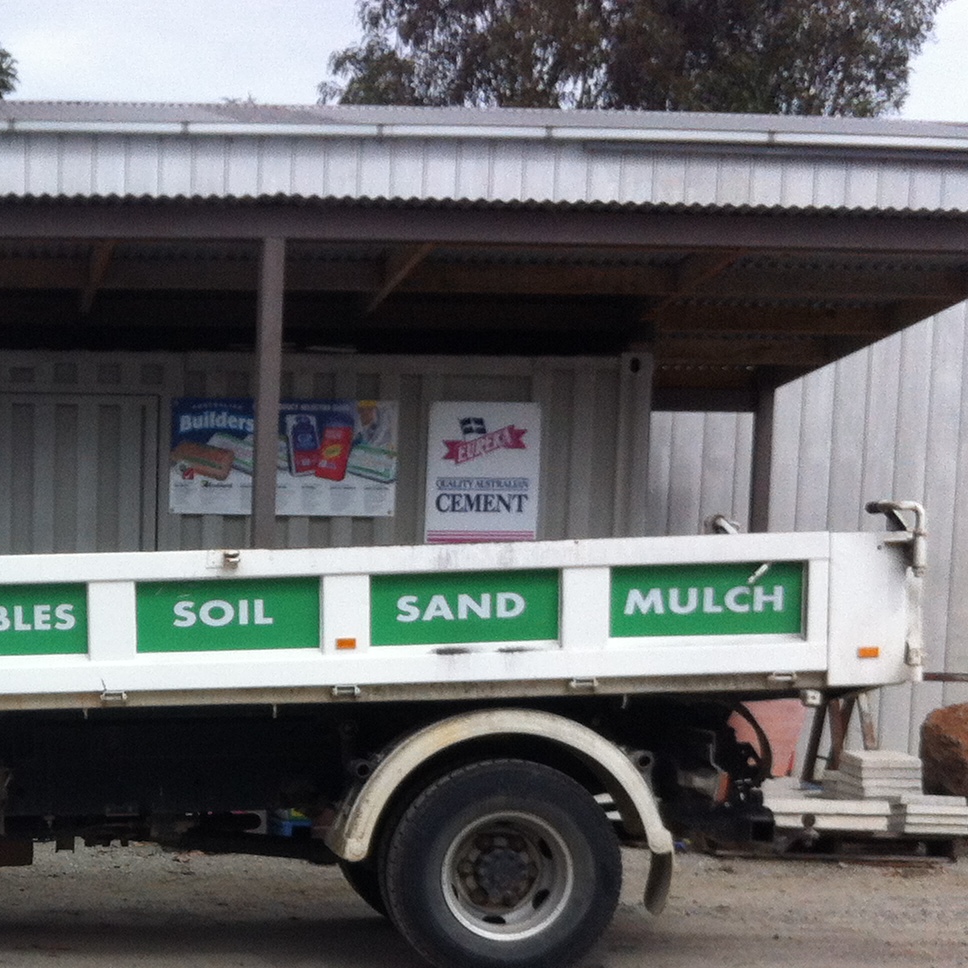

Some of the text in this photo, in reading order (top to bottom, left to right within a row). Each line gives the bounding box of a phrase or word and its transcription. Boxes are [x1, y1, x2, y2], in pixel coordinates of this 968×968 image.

[179, 410, 254, 433] Builders
[435, 493, 529, 513] CEMENT
[173, 599, 274, 628] SOIL
[396, 591, 526, 622] SAND
[623, 585, 785, 616] MULCH
